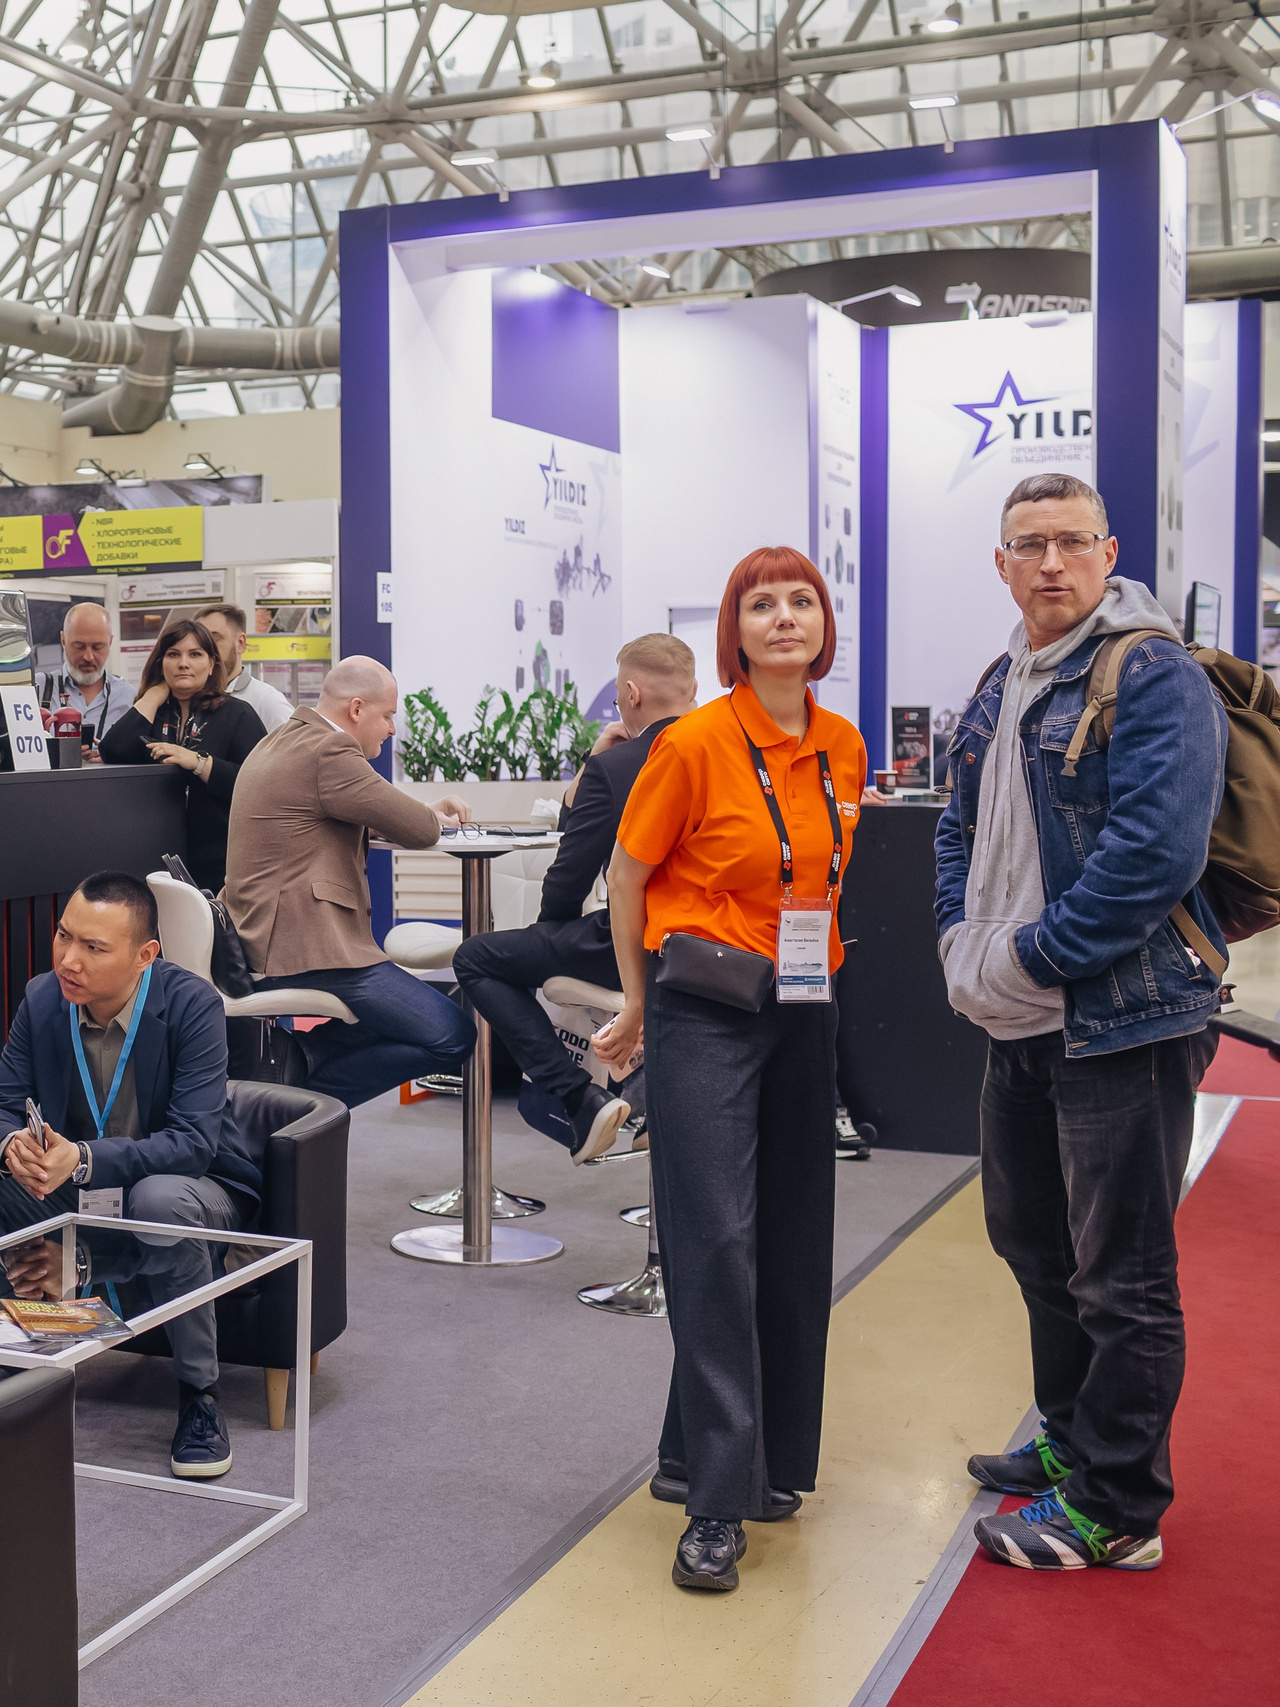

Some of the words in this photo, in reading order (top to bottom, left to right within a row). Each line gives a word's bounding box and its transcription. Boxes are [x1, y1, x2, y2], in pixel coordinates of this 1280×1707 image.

[552, 477, 587, 506] YILDIZ
[96, 526, 174, 537] ХЛОРОПРЕНОВЫЕ
[96, 538, 182, 549] ТЕХНОЛОГИЧЕСКИЕ
[96, 552, 138, 562] ДОБАВКИ
[382, 584, 391, 593] FC
[13, 704, 33, 721] FC
[16, 736, 43, 753] 070
